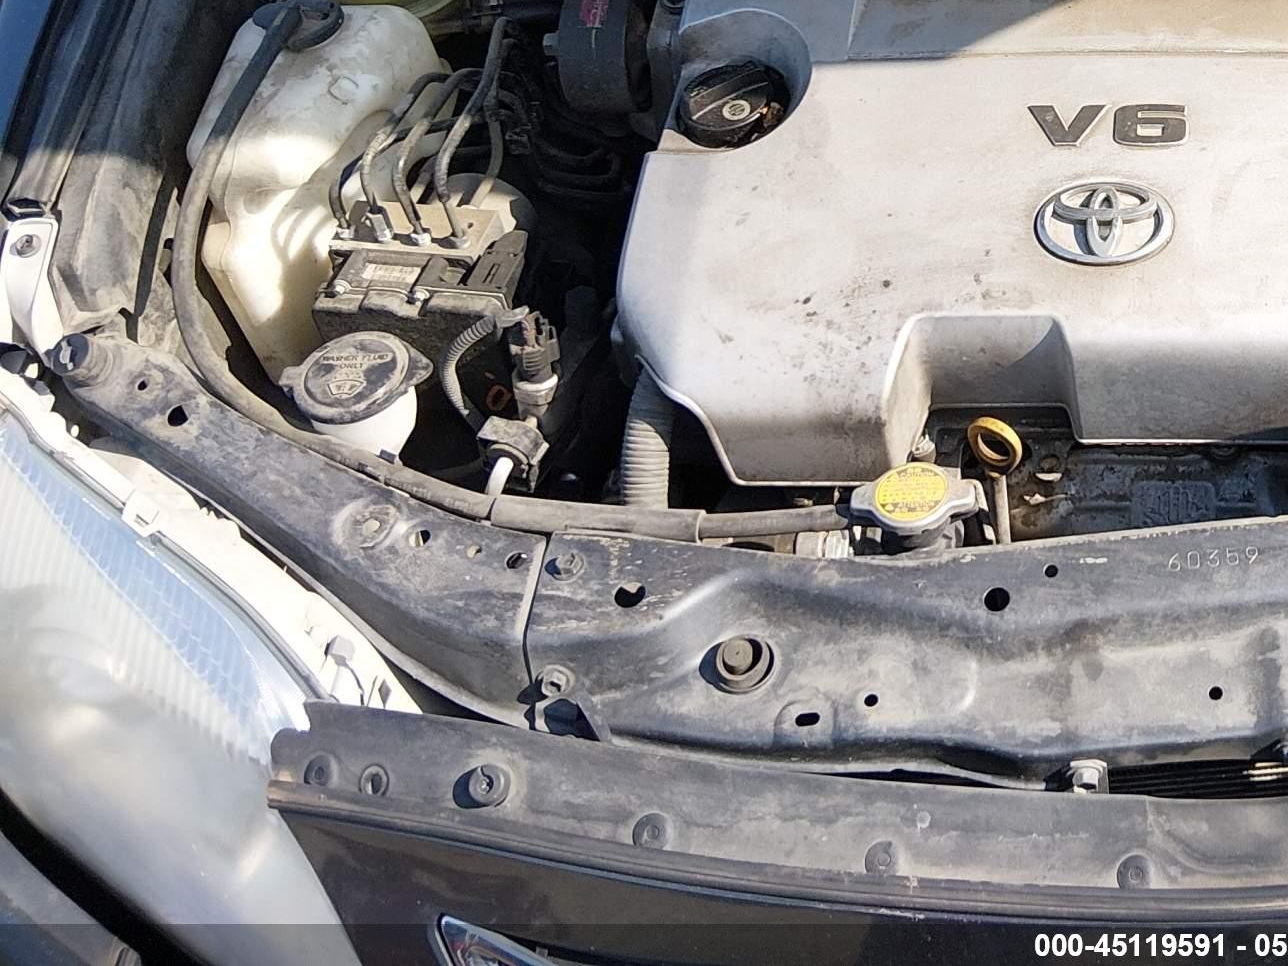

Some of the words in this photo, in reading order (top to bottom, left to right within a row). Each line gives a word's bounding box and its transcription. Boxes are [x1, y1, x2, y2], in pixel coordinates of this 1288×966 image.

[1027, 103, 1191, 148] V6
[362, 352, 390, 362] FLUID
[1168, 546, 1259, 572] 60359
